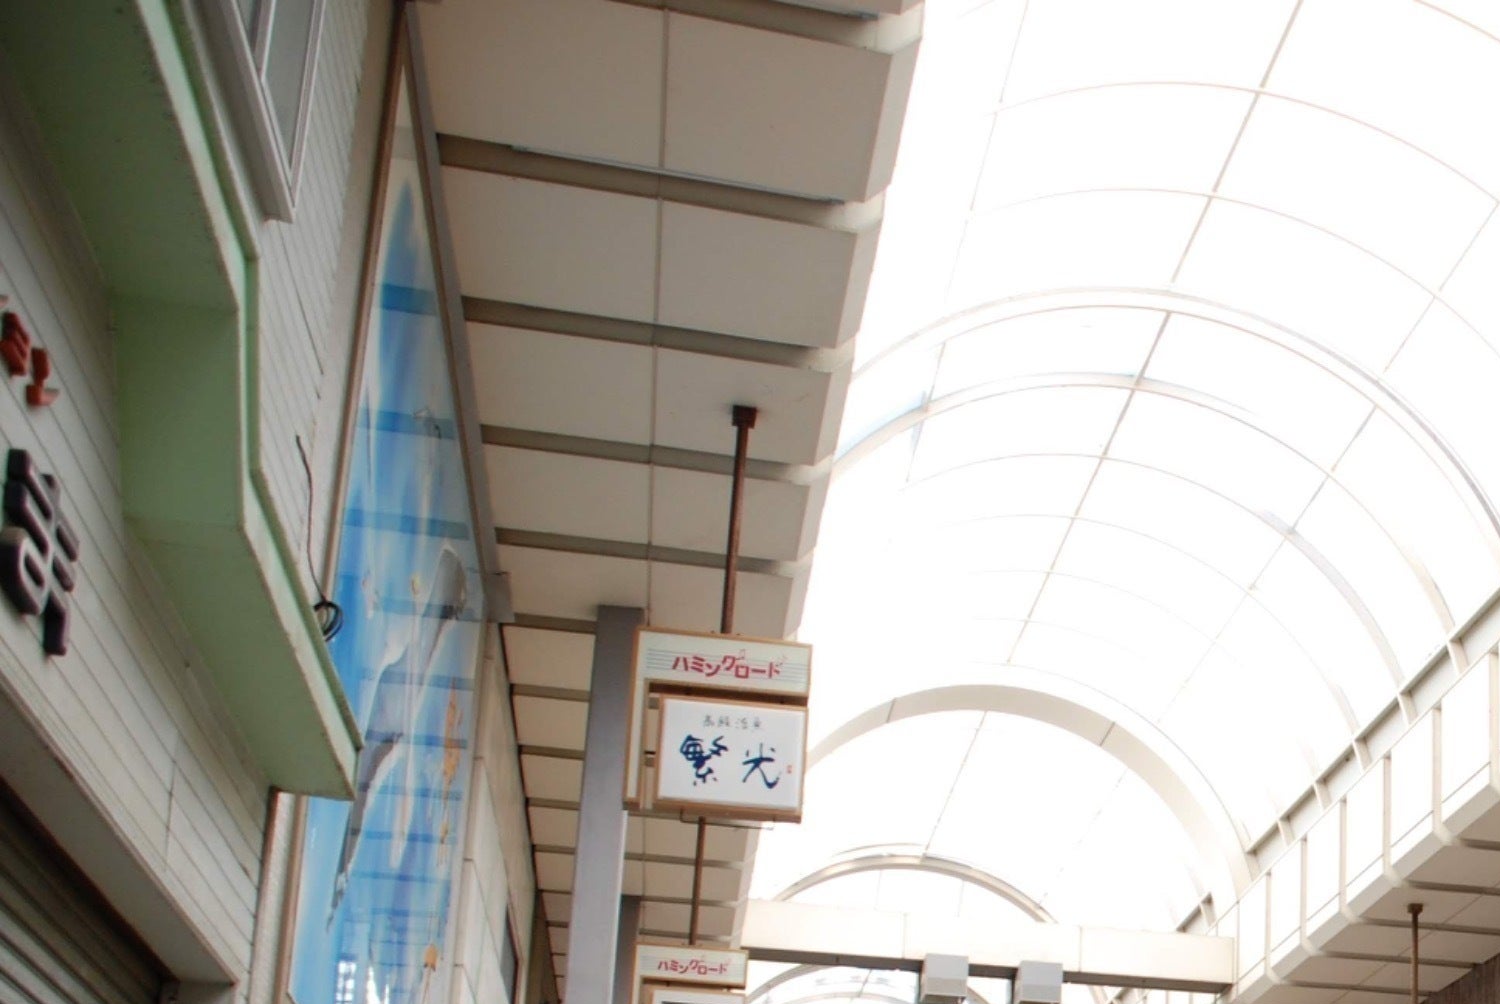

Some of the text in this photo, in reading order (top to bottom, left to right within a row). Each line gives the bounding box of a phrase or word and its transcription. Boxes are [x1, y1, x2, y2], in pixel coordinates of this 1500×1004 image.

[672, 653, 785, 679] ハミングロード
[658, 958, 729, 975] ハミングロード
